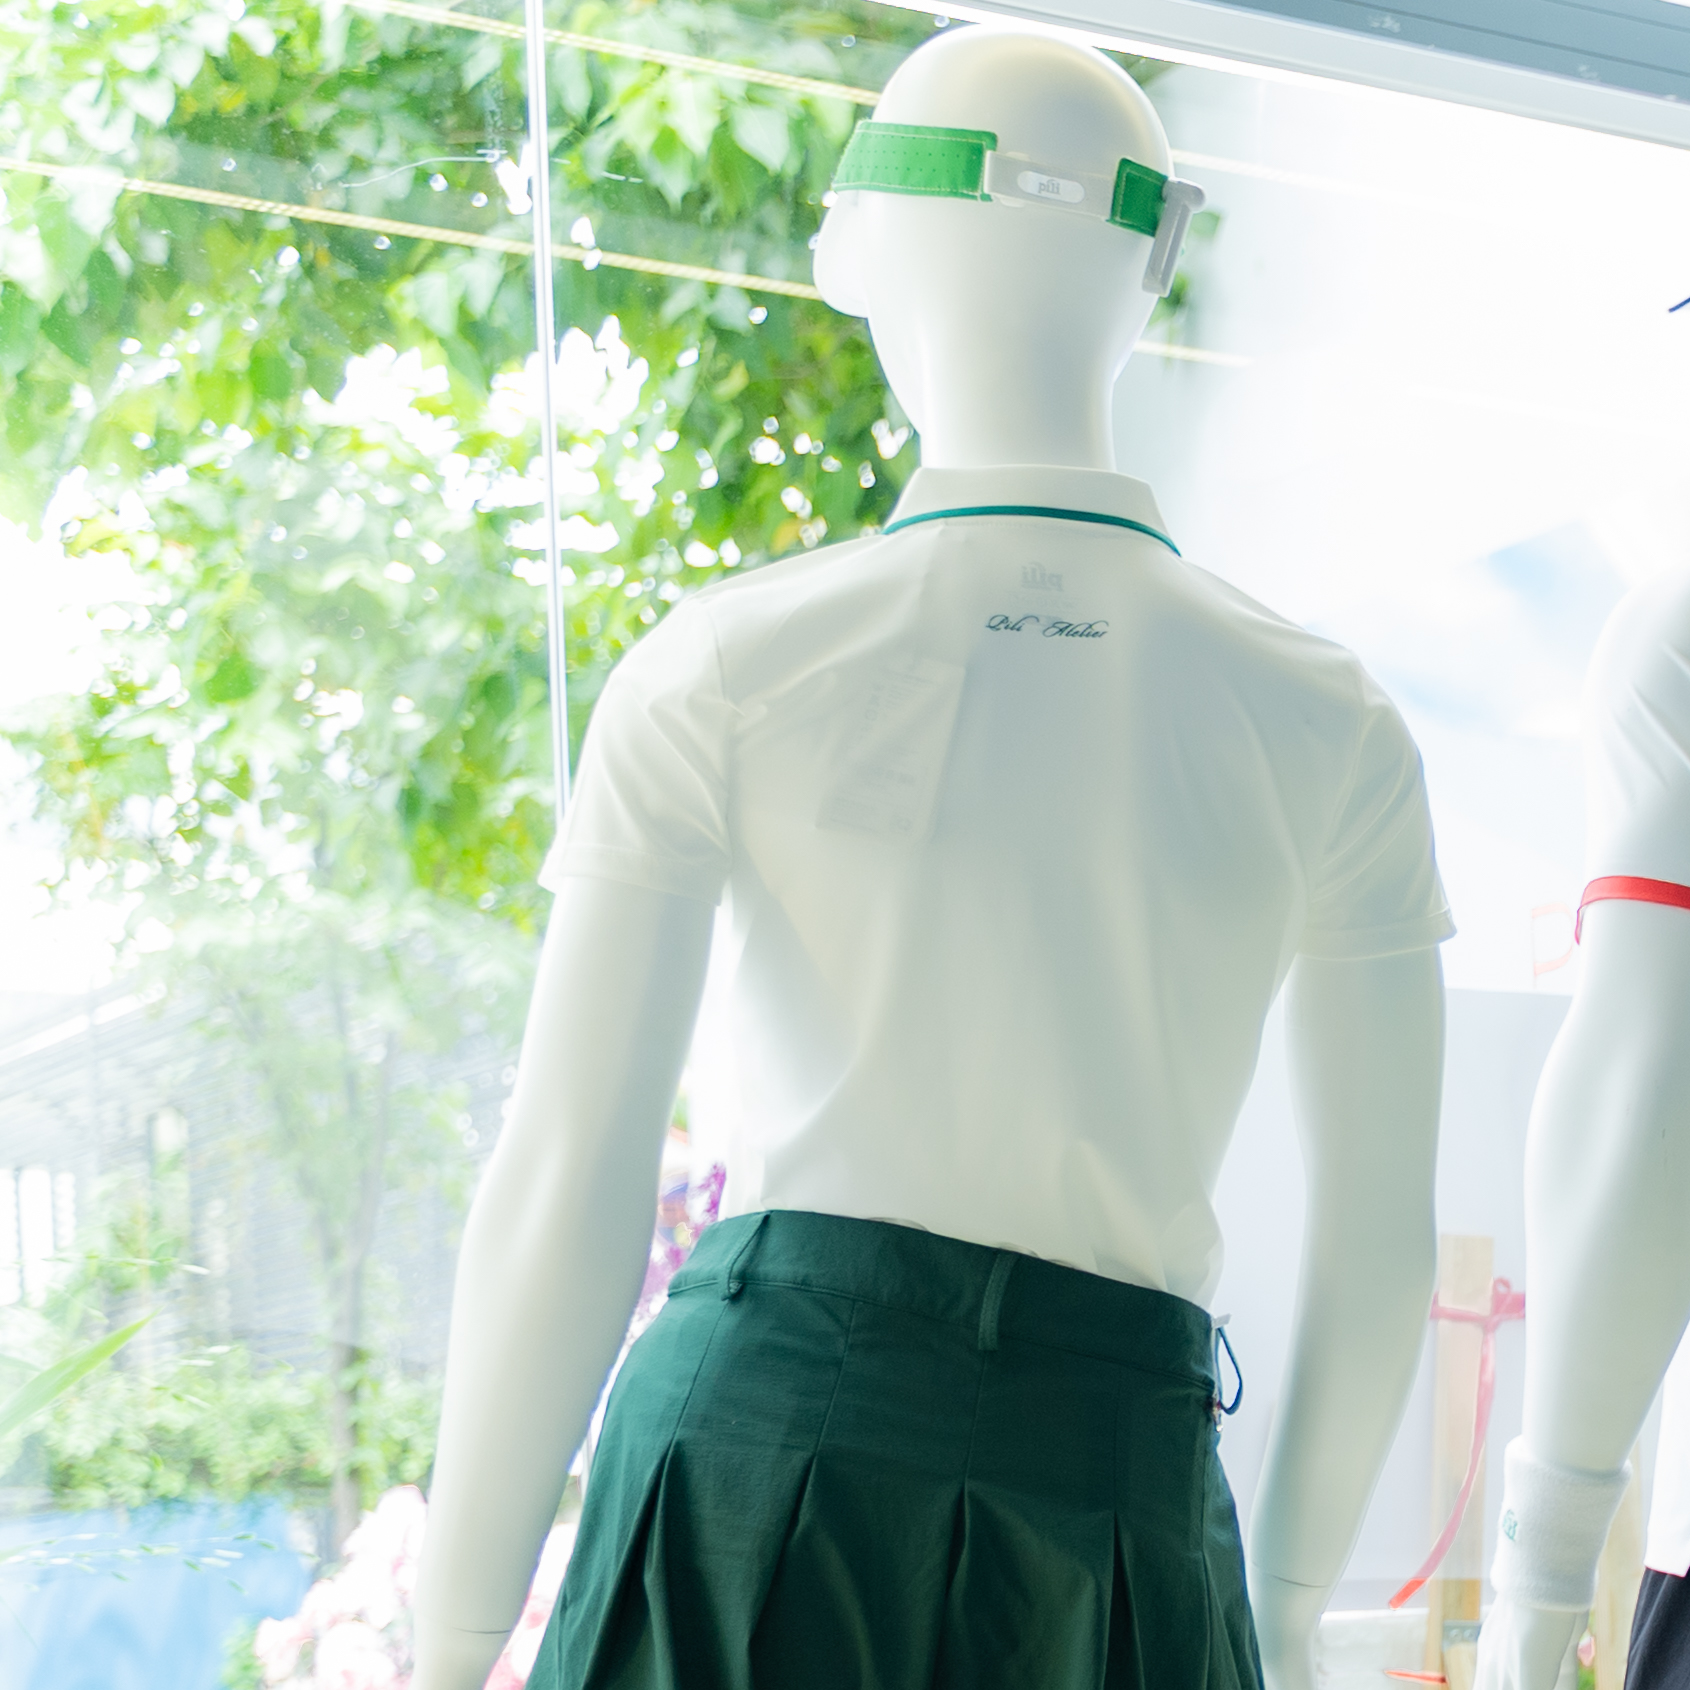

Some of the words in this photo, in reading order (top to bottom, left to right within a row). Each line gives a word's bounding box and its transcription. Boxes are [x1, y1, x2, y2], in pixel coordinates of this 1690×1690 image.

[1037, 178, 1061, 195] pili
[985, 614, 1040, 632] Pili
[1042, 619, 1109, 638] Atelier
